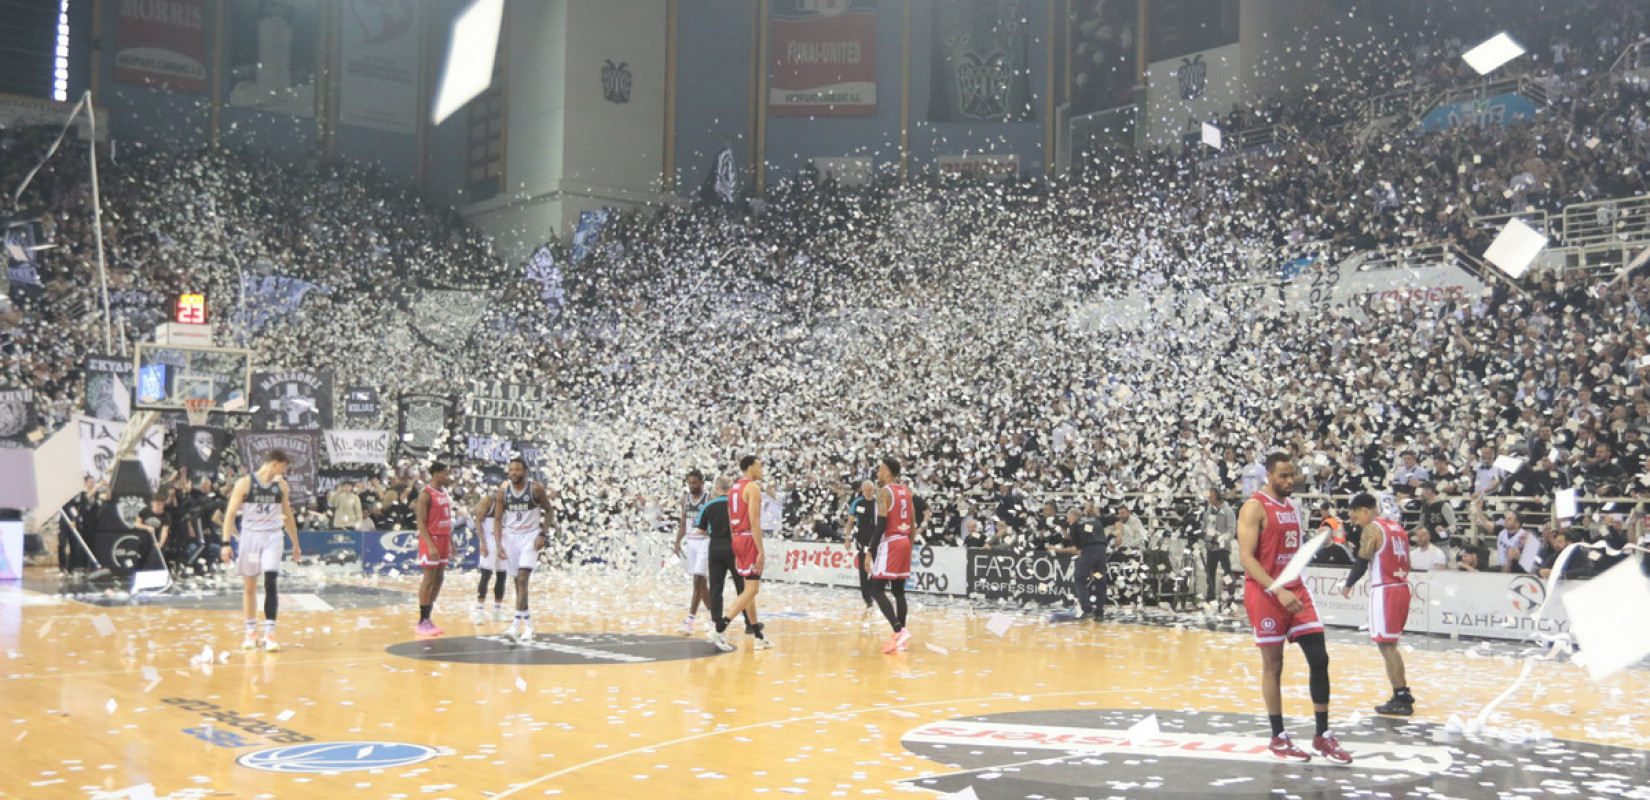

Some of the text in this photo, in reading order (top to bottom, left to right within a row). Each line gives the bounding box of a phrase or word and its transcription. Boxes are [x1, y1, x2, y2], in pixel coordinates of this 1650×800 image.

[119, 0, 203, 29] MORRIS
[787, 40, 861, 64] FUNAI-UNITED
[177, 301, 205, 324] 23
[89, 359, 134, 372] ΣΚΥΔΡ
[79, 420, 159, 450] ΠΑΚ
[256, 503, 270, 514] 34
[1275, 511, 1298, 524] CHOLE
[1285, 530, 1297, 548] 25
[974, 554, 1075, 584] FARCOM
[1441, 611, 1570, 633] ΣΙΔΗΡΟΠΟΥ
